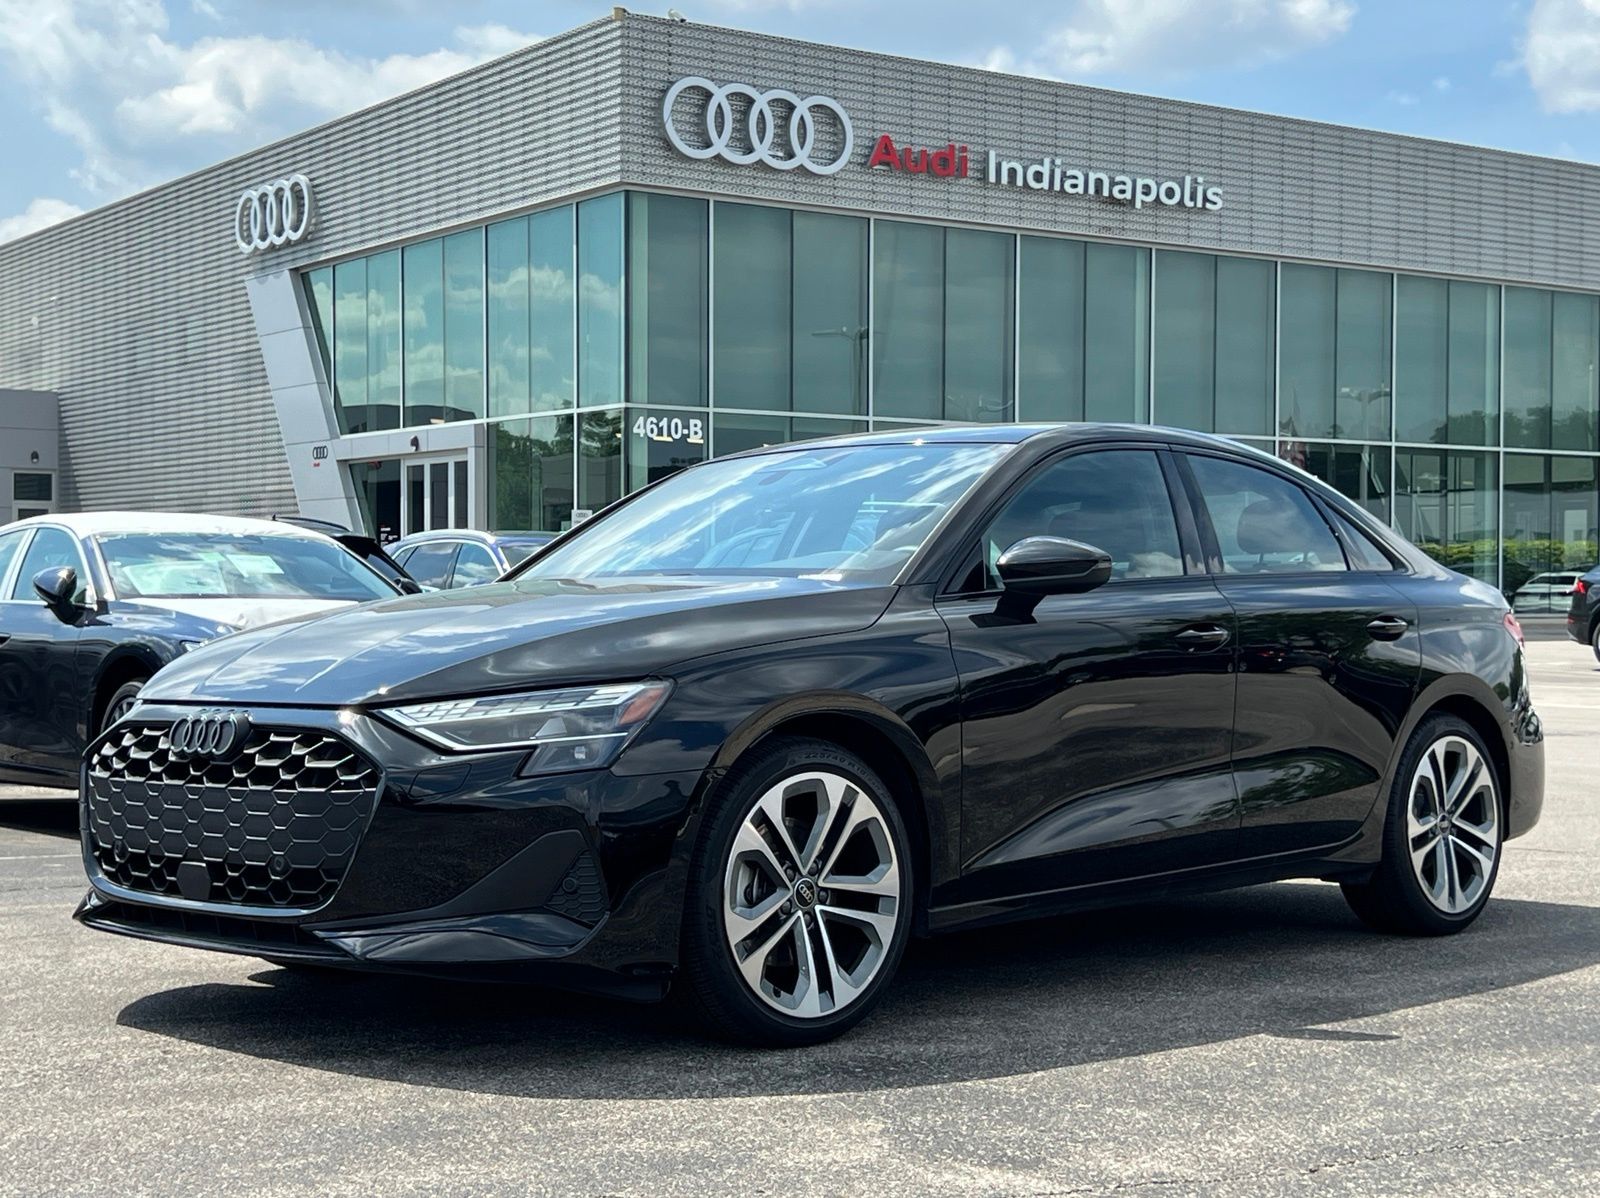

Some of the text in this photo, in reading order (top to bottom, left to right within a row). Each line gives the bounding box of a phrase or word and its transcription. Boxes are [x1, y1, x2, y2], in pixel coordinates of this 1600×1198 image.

[869, 133, 1223, 211] Audi Indianapolis
[633, 416, 703, 439] 4610-B
